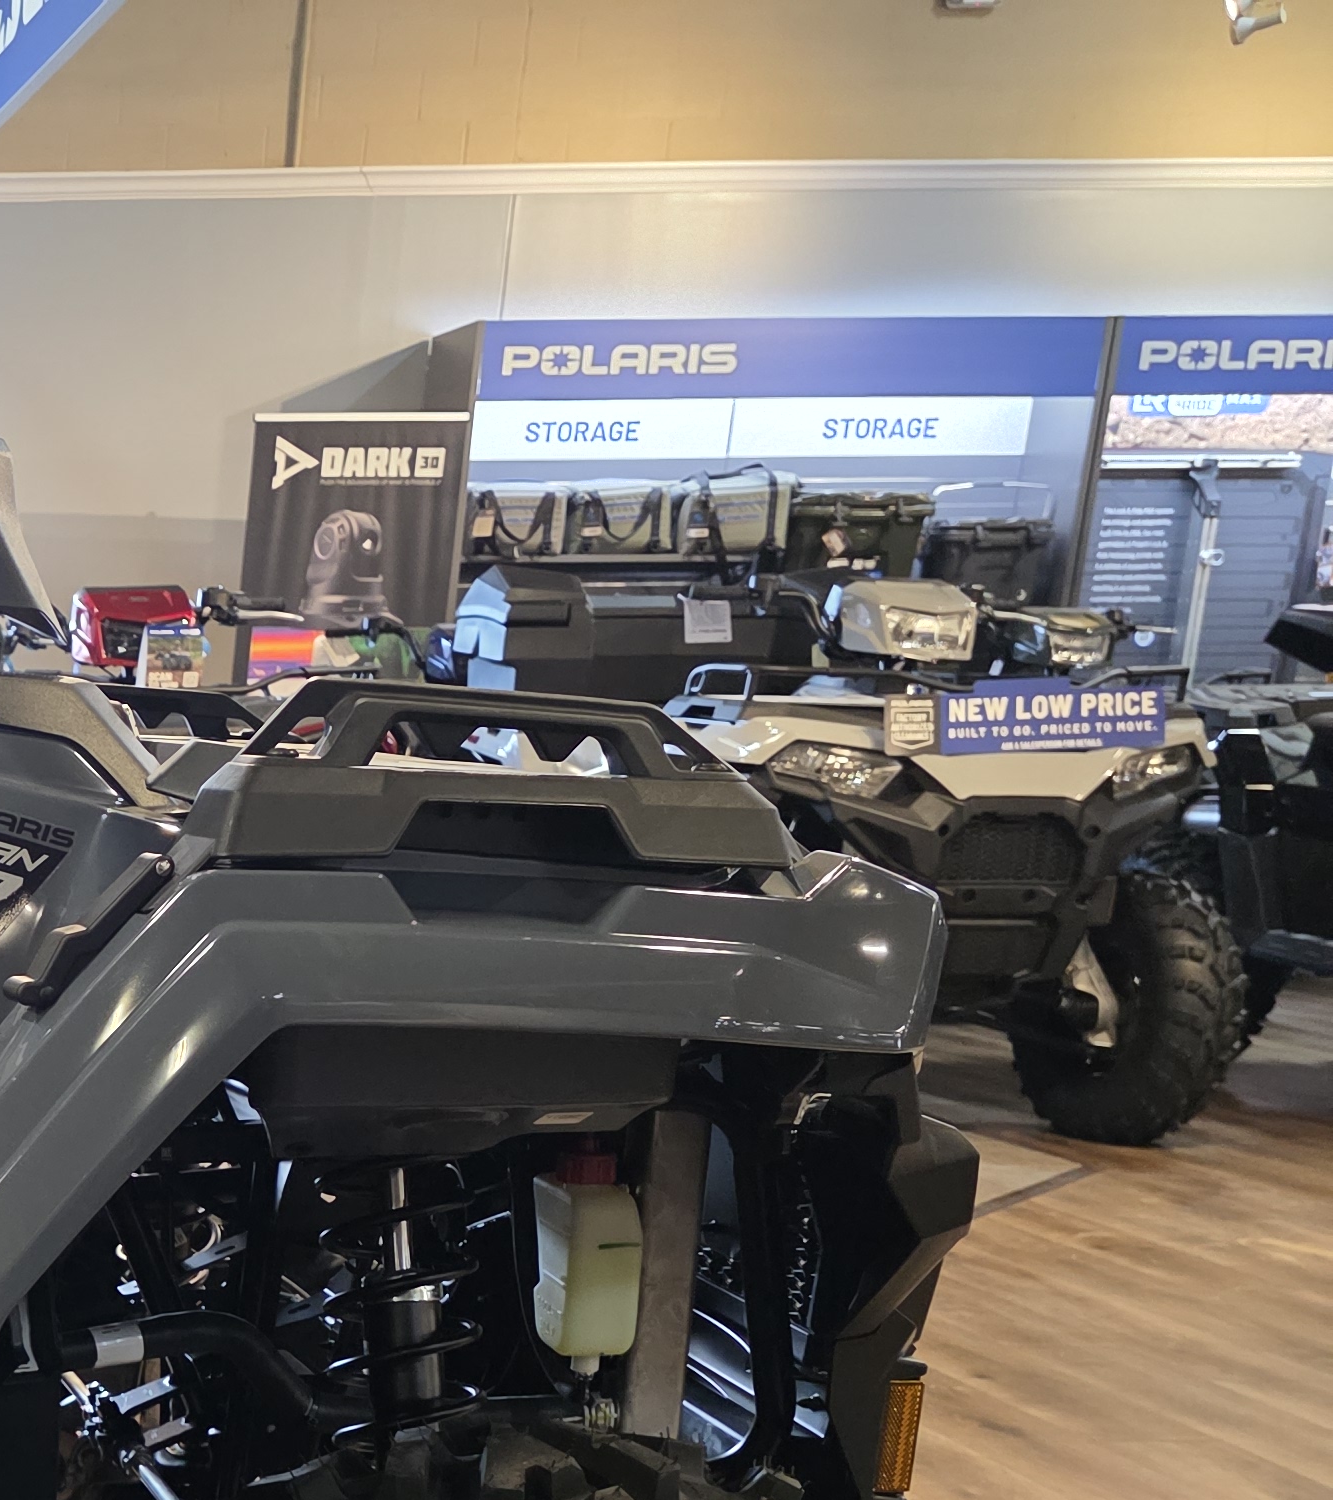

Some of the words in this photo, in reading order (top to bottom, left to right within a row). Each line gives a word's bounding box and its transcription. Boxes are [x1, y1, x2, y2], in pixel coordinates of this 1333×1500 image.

[501, 342, 738, 376] POLARIS
[524, 420, 641, 443] STORAGE
[821, 417, 939, 440] STORAGE
[320, 446, 412, 478] DARK
[948, 696, 1009, 723] NEW
[1015, 694, 1074, 720] LOW
[1080, 691, 1158, 717] PRICE
[948, 727, 987, 739] BUILT
[991, 726, 1009, 737] TO
[1013, 725, 1036, 737] GO.
[1040, 723, 1091, 735] PRICED
[1095, 722, 1111, 733] TO
[1116, 720, 1158, 732] MOVE.
